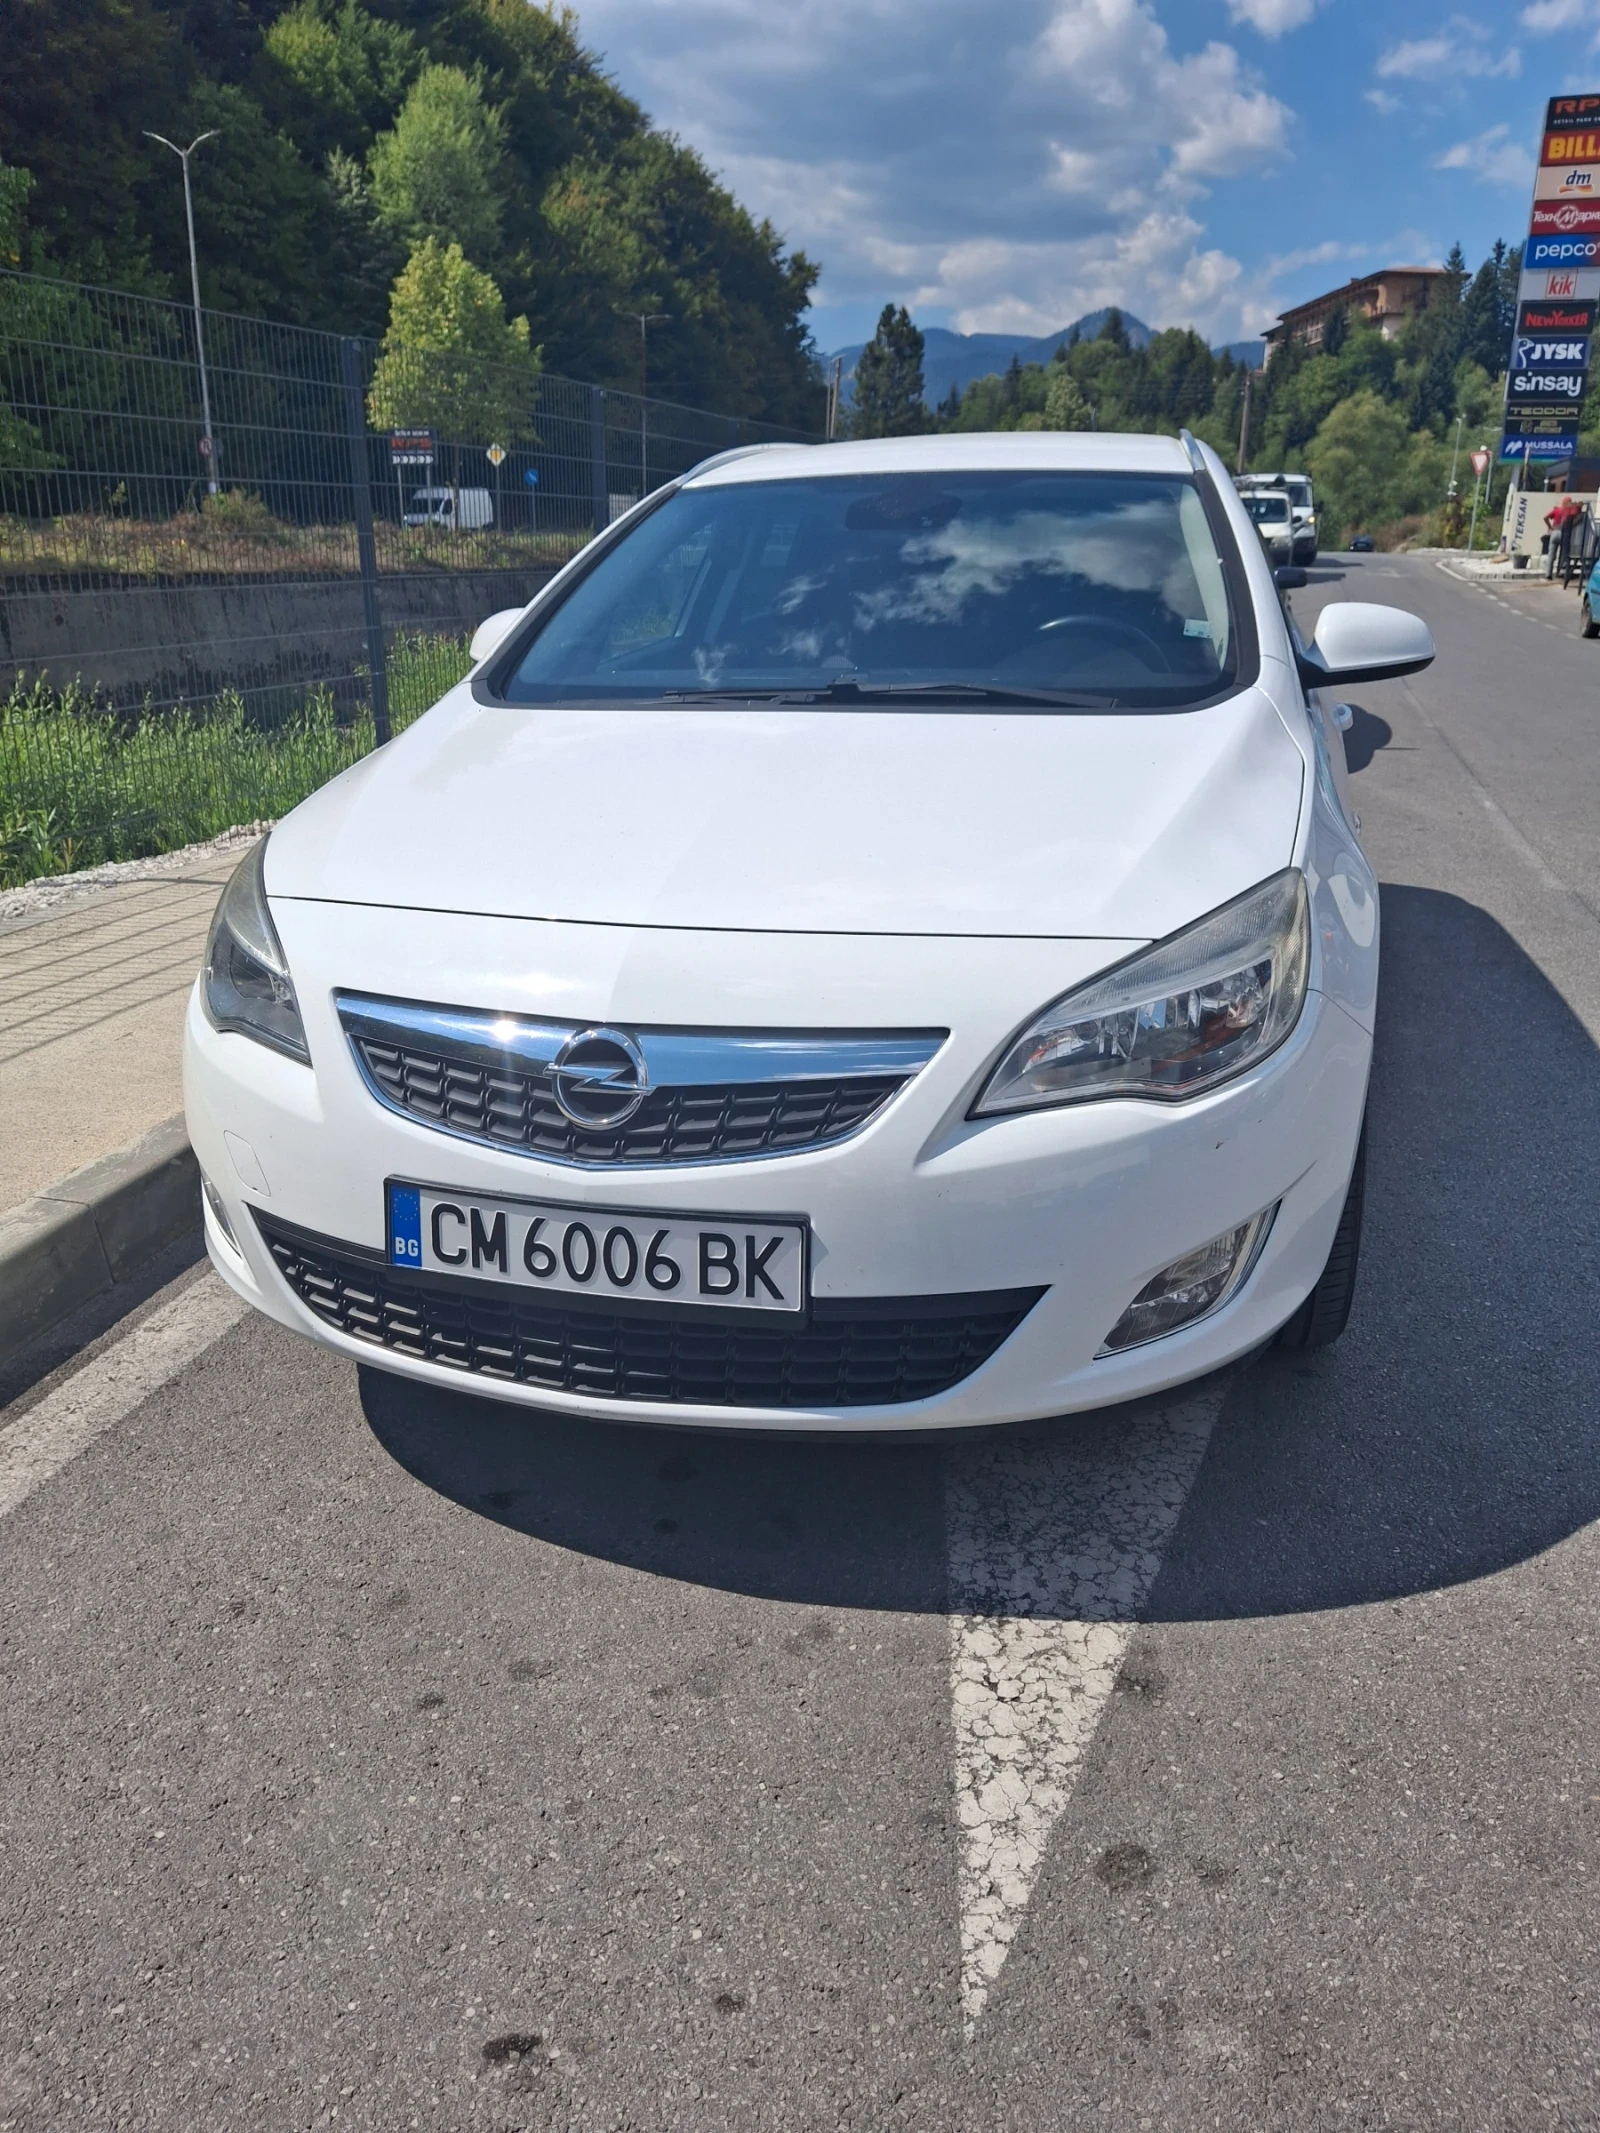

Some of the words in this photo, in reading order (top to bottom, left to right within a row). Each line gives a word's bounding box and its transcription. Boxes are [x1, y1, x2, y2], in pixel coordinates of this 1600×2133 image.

[1549, 135, 1600, 159] BILL
[1565, 170, 1592, 186] dm
[1535, 243, 1597, 260] pepco
[1548, 272, 1574, 296] kik
[1530, 343, 1584, 360] JYSK
[1514, 371, 1582, 397] sinsay
[1510, 407, 1578, 415] TEODOR
[1525, 440, 1573, 449] MUSSALA
[1514, 496, 1528, 540] TEKSAN
[394, 1235, 420, 1258] BG
[430, 1202, 508, 1273] CM
[523, 1216, 681, 1291] 6006
[698, 1232, 785, 1300] BK
